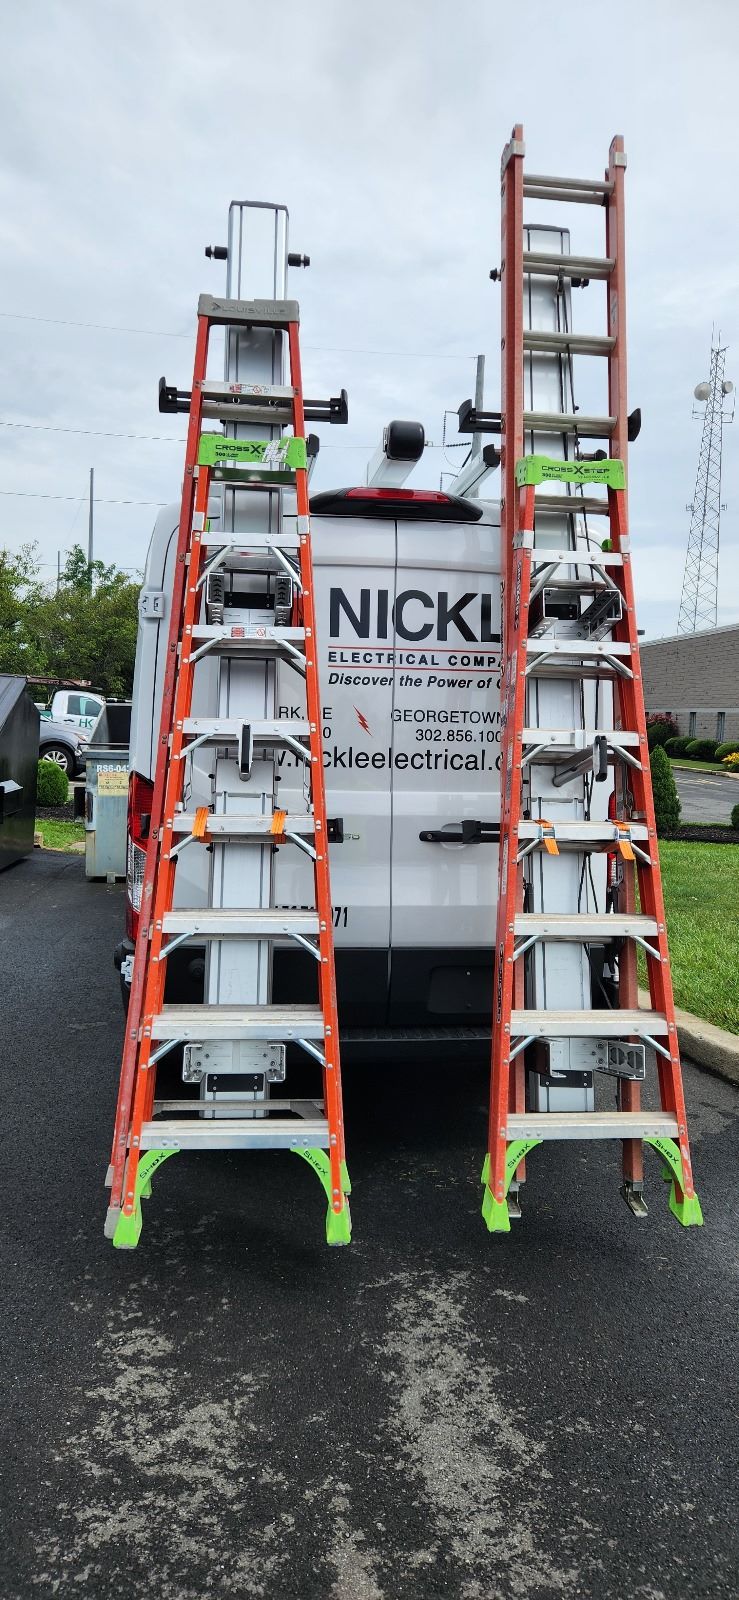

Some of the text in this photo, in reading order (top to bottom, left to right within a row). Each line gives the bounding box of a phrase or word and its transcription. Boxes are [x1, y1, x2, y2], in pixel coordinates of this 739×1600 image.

[329, 587, 501, 643] NICKL
[328, 651, 439, 666] ELECTRICAL
[328, 672, 394, 687] Discover
[399, 675, 423, 688] the
[427, 676, 473, 689] Power
[477, 677, 493, 689] of
[415, 729, 501, 743] 302.856.100
